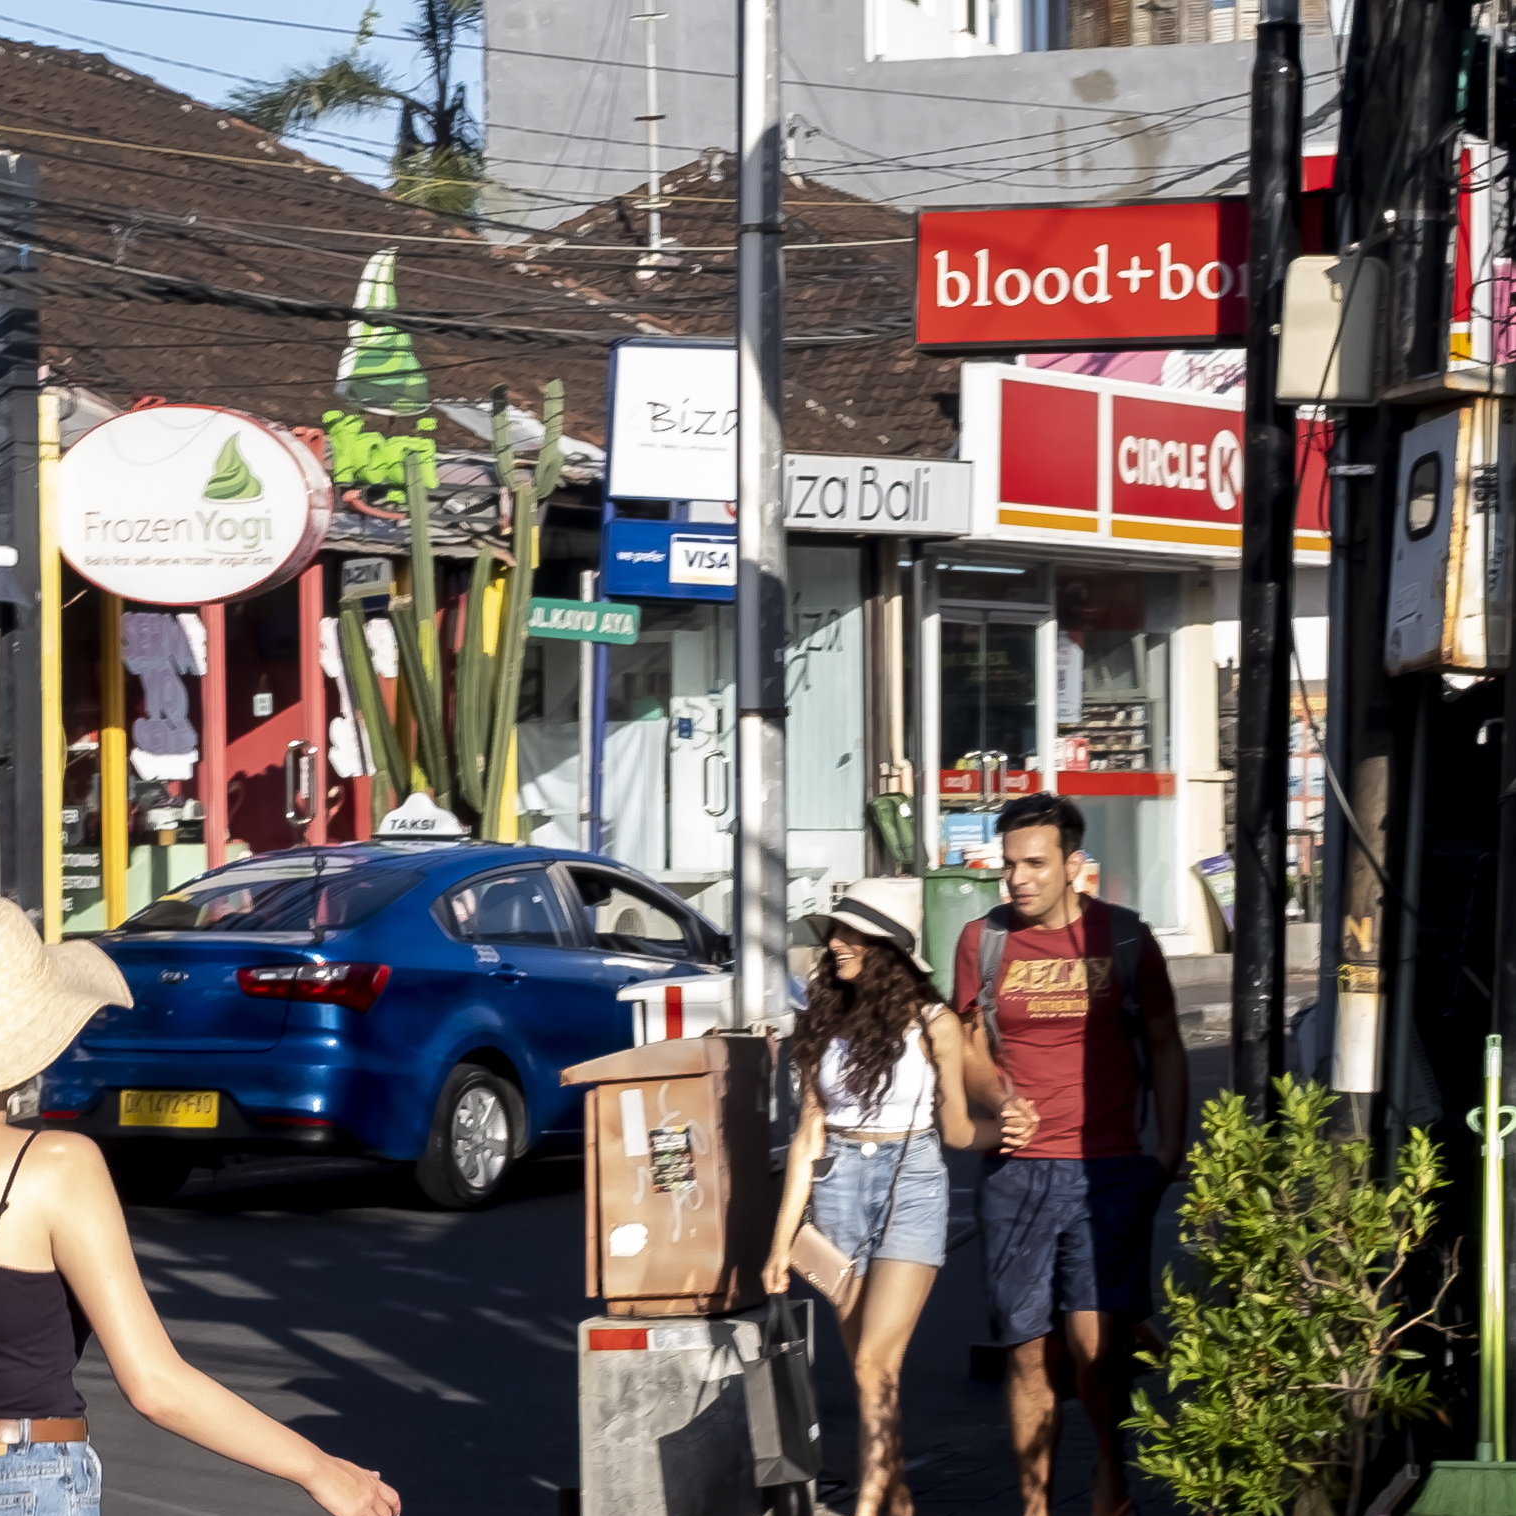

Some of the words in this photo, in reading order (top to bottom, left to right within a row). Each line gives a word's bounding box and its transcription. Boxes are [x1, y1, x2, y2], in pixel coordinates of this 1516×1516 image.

[1118, 435, 1208, 491] CIRCLE
[783, 458, 849, 519] iza
[857, 464, 932, 522] Bali
[683, 549, 731, 570] VISA
[390, 818, 437, 831] TAKSI
